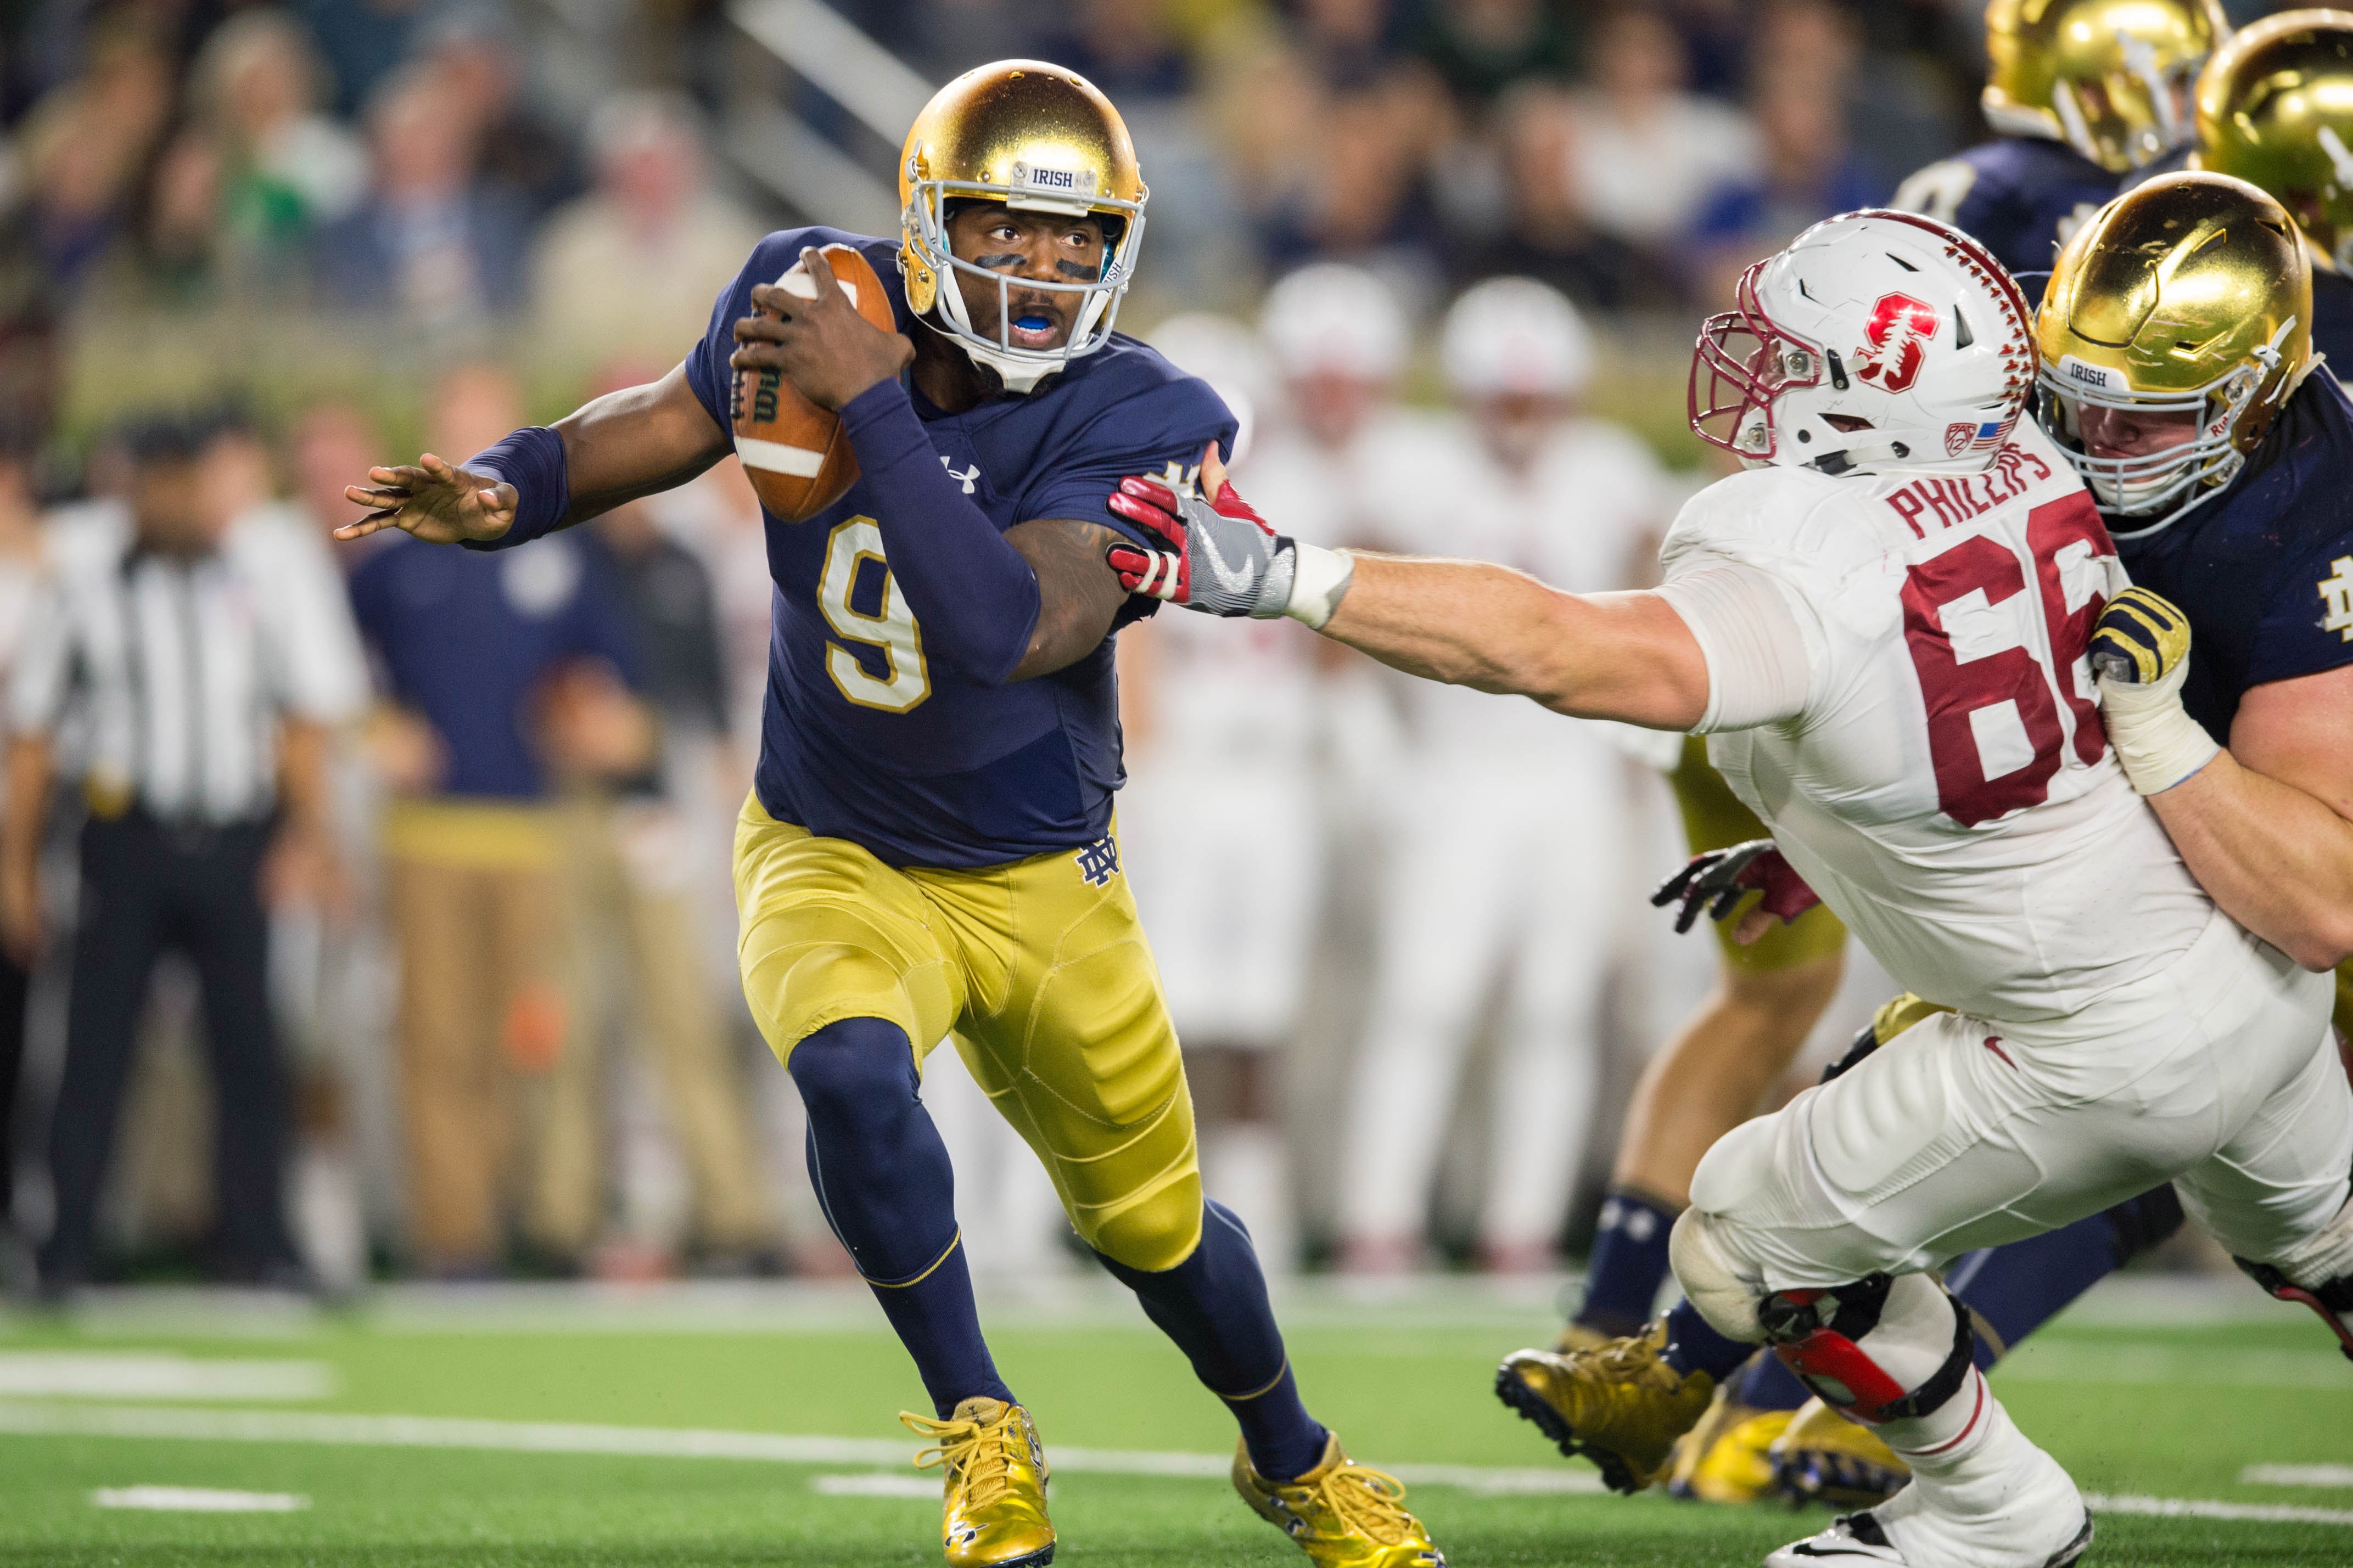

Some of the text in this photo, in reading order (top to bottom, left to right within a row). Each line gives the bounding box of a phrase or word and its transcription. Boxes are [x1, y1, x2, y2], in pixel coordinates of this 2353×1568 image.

[1033, 169, 1072, 188] IRISH
[2070, 363, 2107, 387] IRISH
[1949, 439, 1965, 449] 12
[1885, 442, 2051, 540] PHILLIPS
[816, 514, 932, 714] 9
